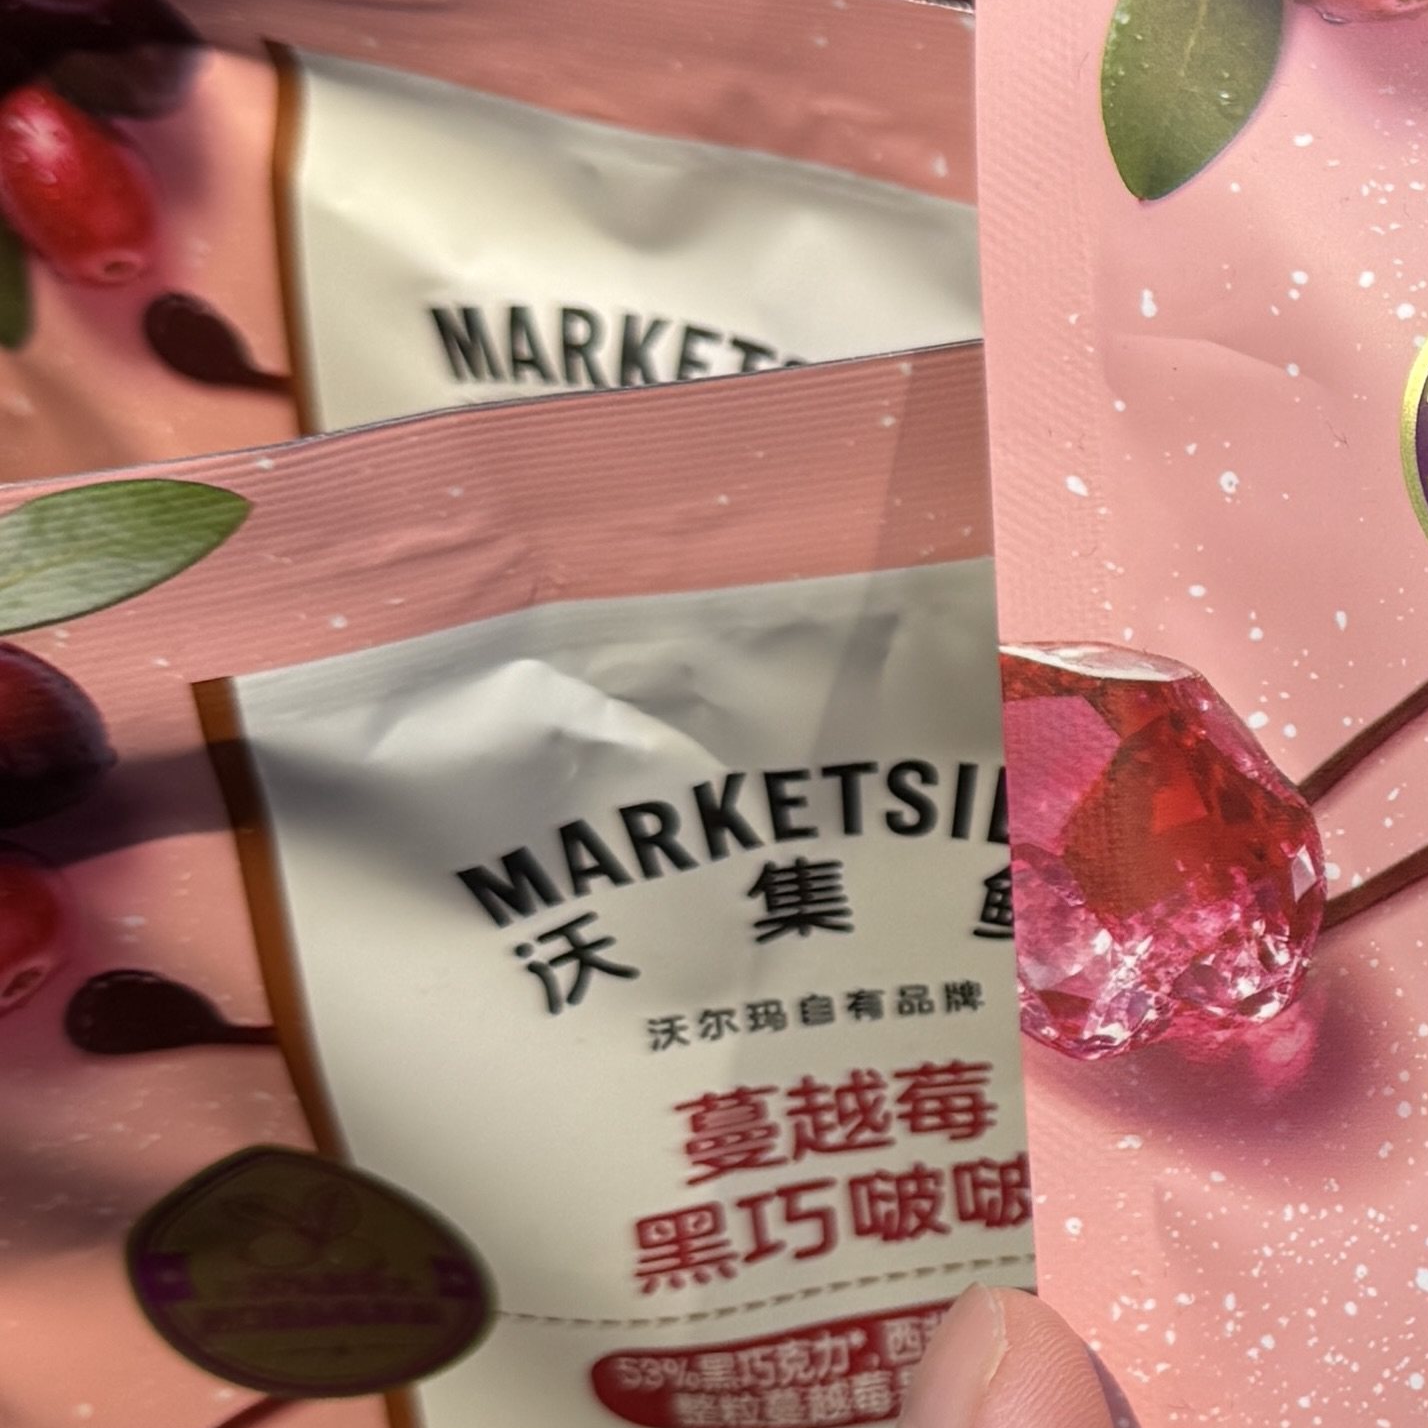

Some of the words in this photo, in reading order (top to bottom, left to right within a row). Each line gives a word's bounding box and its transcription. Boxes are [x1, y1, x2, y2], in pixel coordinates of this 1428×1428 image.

[430, 306, 808, 389] MARKET
[648, 979, 986, 1052] 沃尔玛自有品牌
[673, 1059, 999, 1188] 蔓越莓
